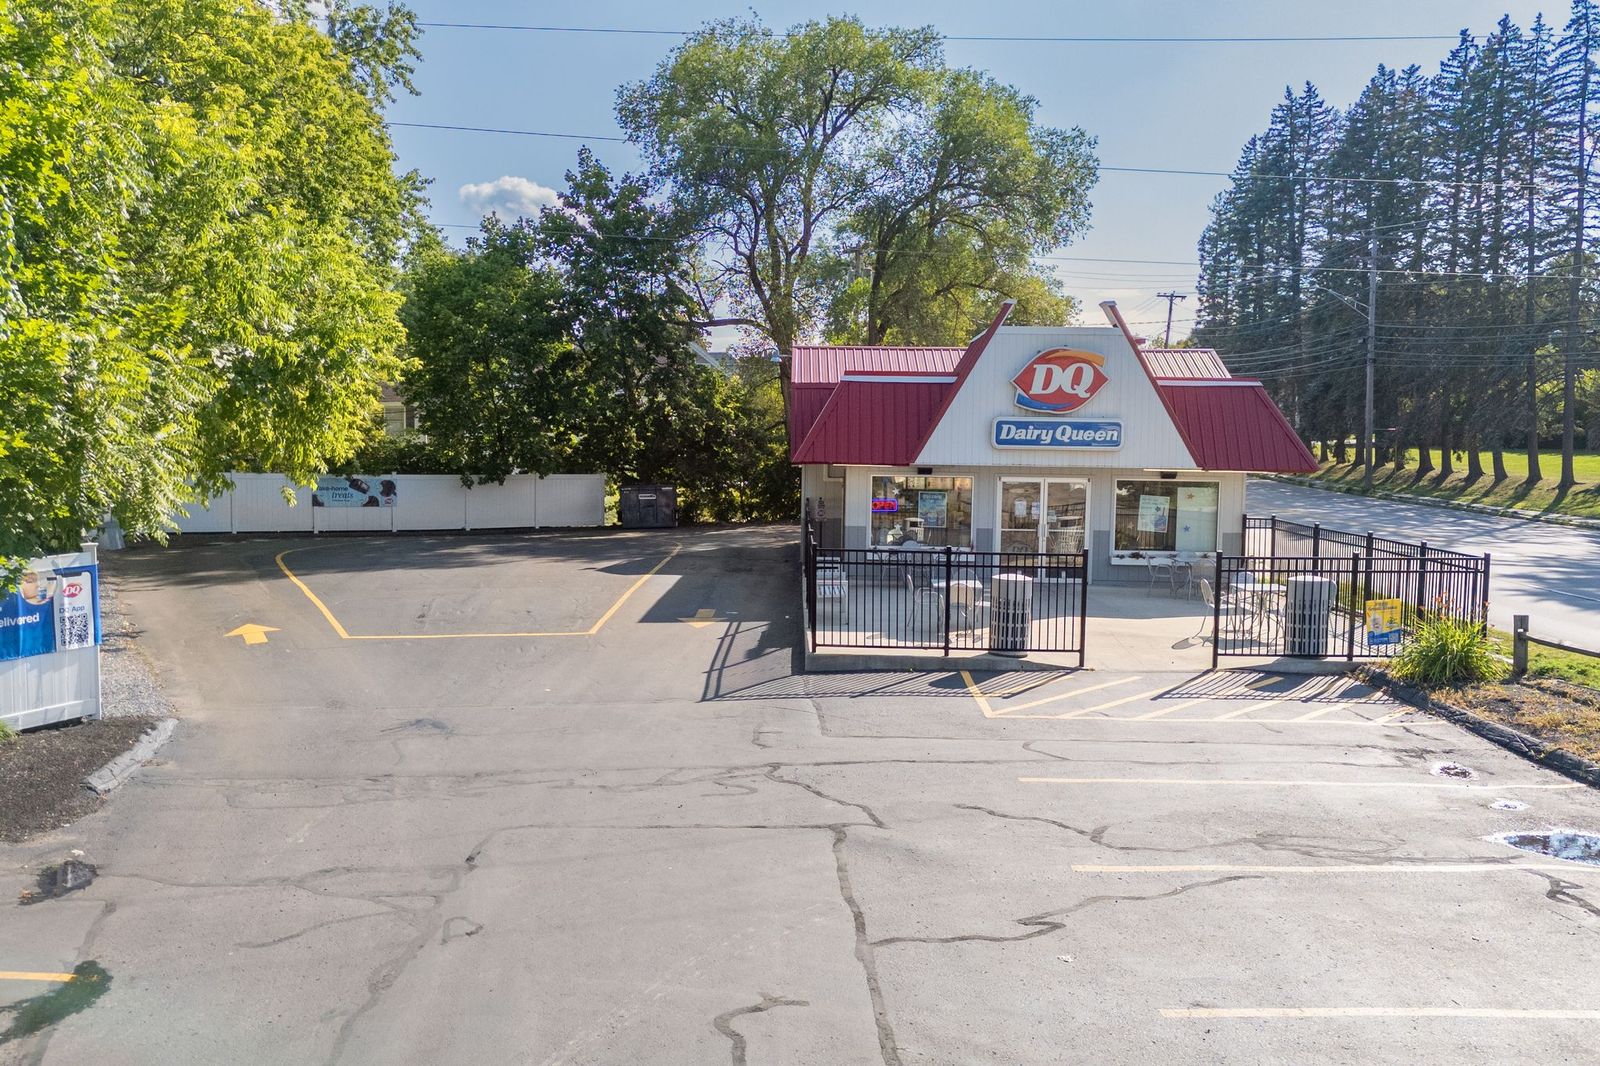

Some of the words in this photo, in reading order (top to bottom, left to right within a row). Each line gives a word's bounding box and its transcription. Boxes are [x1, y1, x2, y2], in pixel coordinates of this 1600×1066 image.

[1029, 362, 1095, 398] DQ
[1000, 424, 1053, 444] Dairy
[1055, 424, 1119, 443] Queen
[872, 501, 896, 510] OPEN
[65, 584, 81, 596] DQ
[72, 605, 85, 613] App
